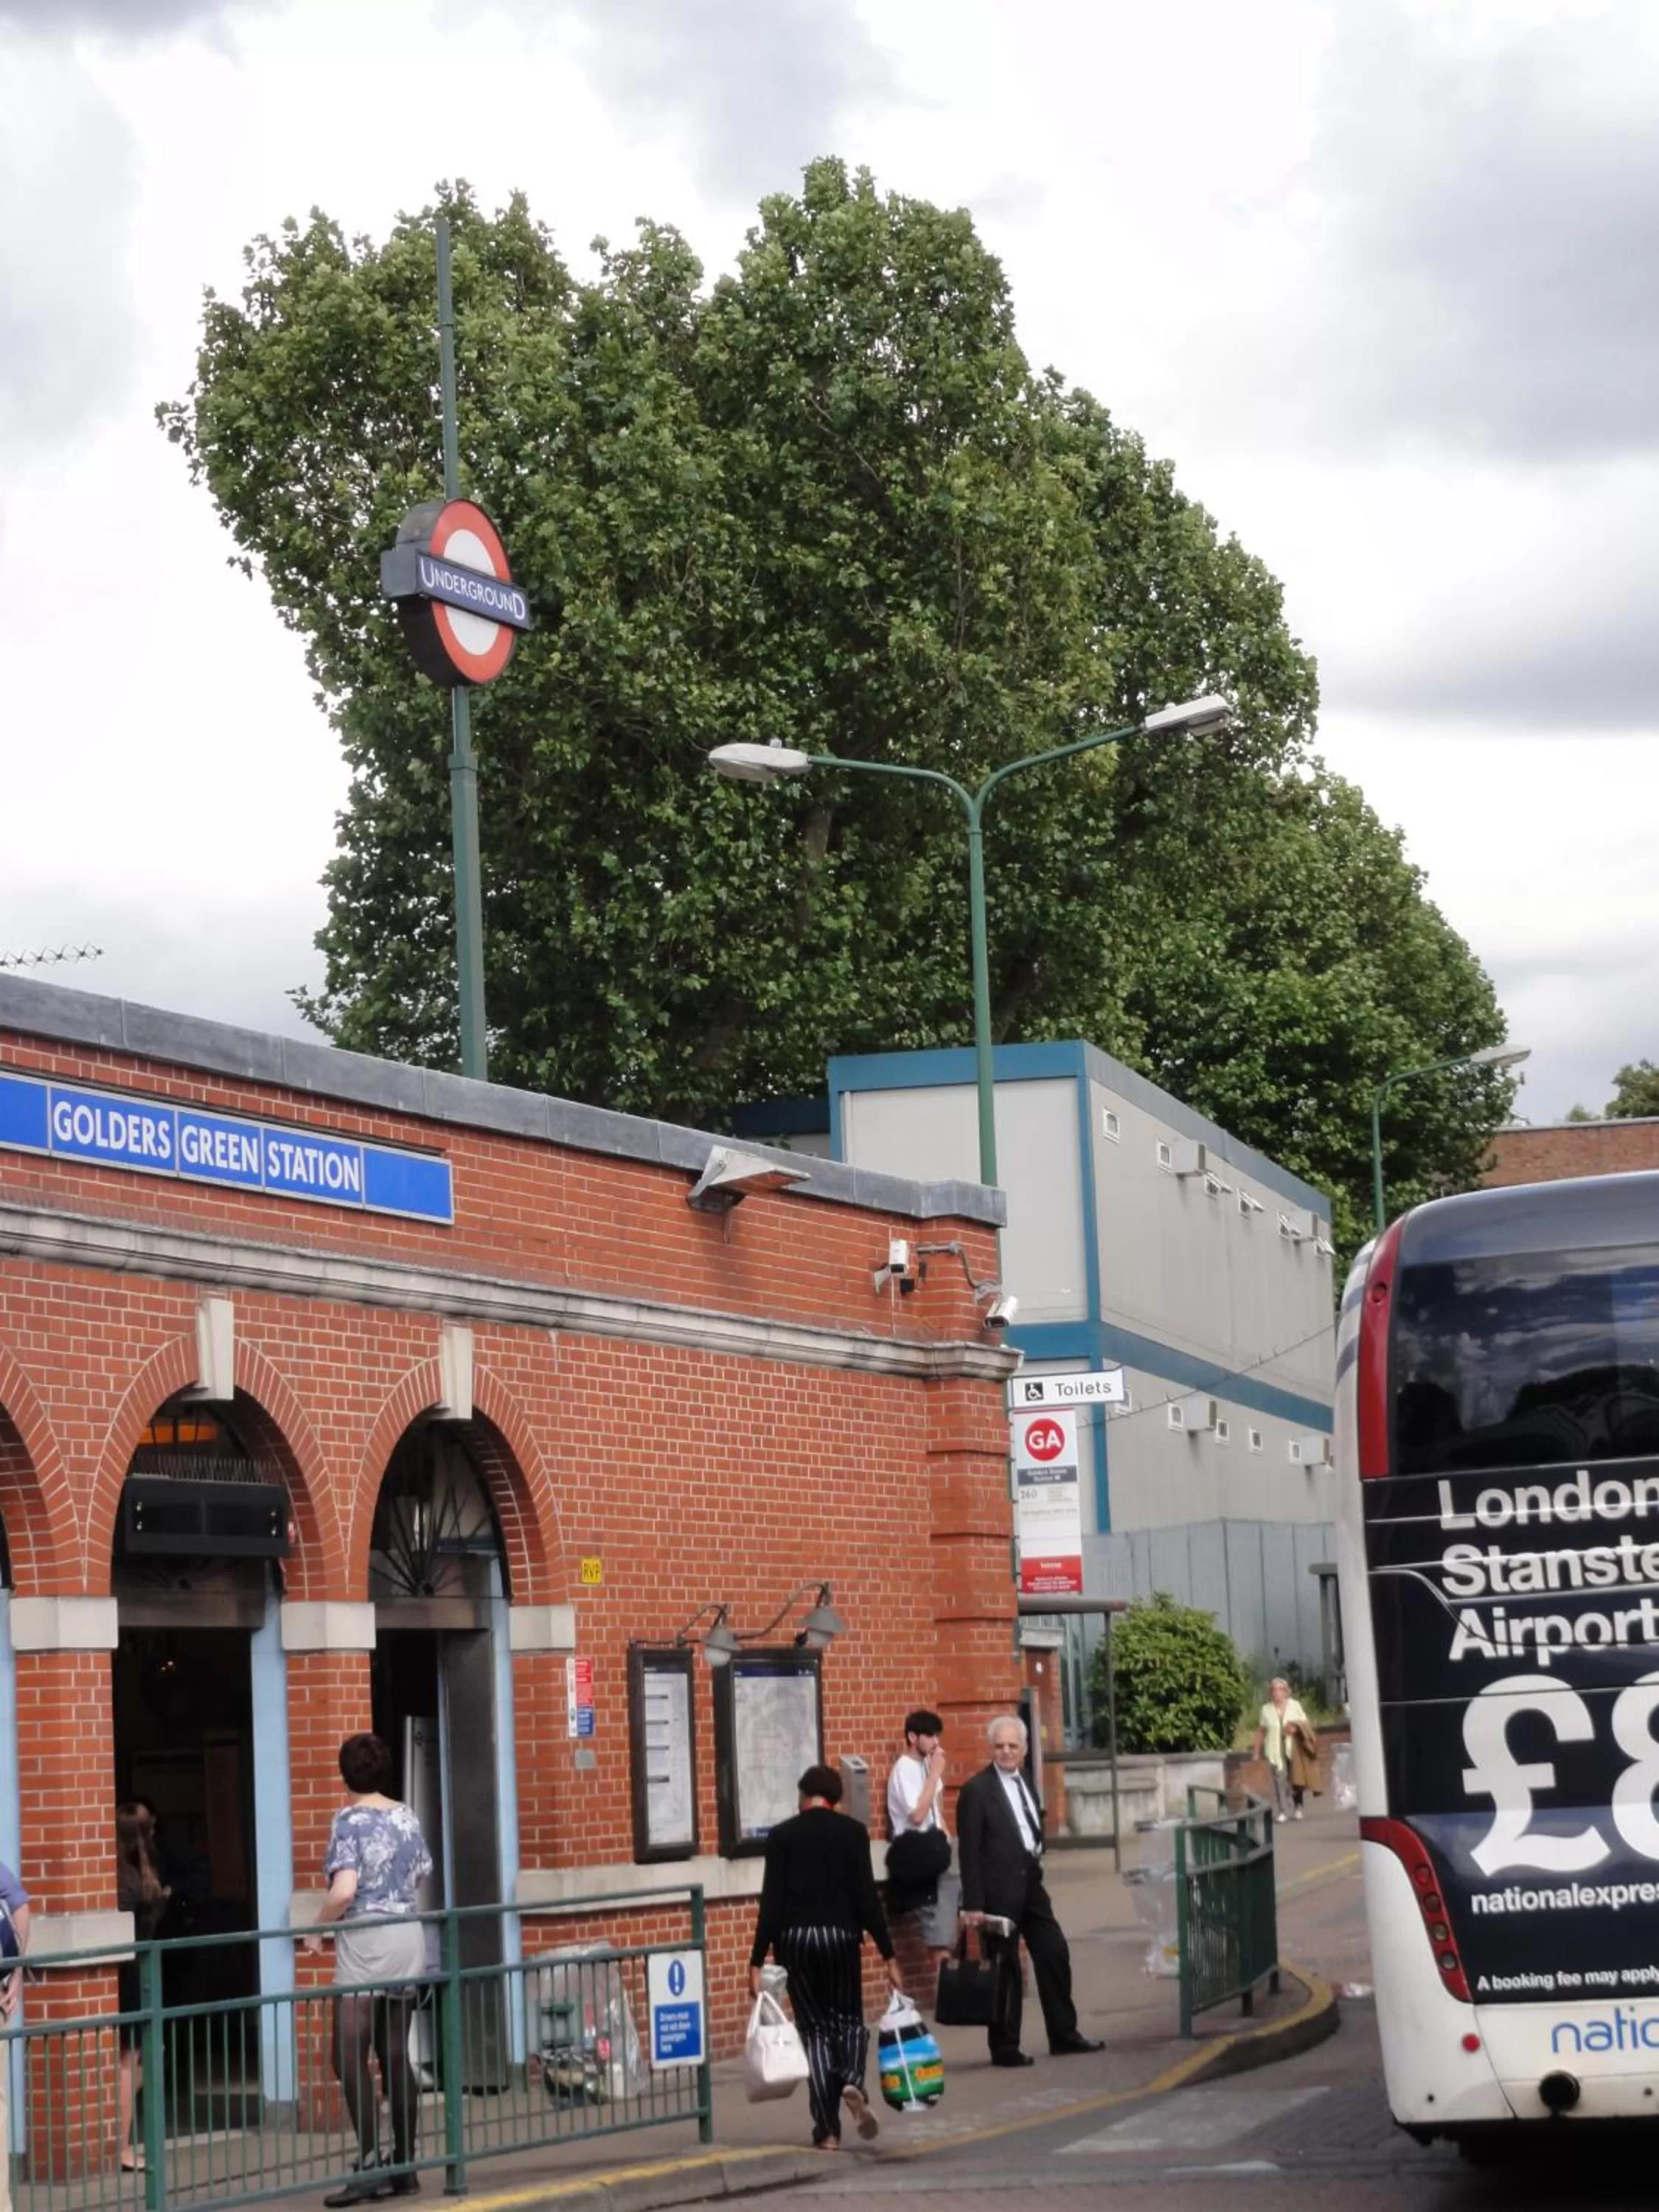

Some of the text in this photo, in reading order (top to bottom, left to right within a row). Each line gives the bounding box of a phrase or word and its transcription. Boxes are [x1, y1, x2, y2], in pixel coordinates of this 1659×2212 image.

[420, 558, 525, 620] UNDERGROUND
[53, 1100, 361, 1192] GOLDERS GREEN STATION
[1054, 1380, 1112, 1397] Toilets
[1028, 1429, 1062, 1450] GA
[1438, 1470, 1659, 1530] London
[1448, 1598, 1659, 1667] Airport
[1471, 1882, 1659, 1914] nationalexpre
[1477, 1975, 1490, 1991] A
[1492, 1972, 1554, 1991] booking
[1557, 1970, 1582, 1986] fee
[1585, 1969, 1619, 1986] may
